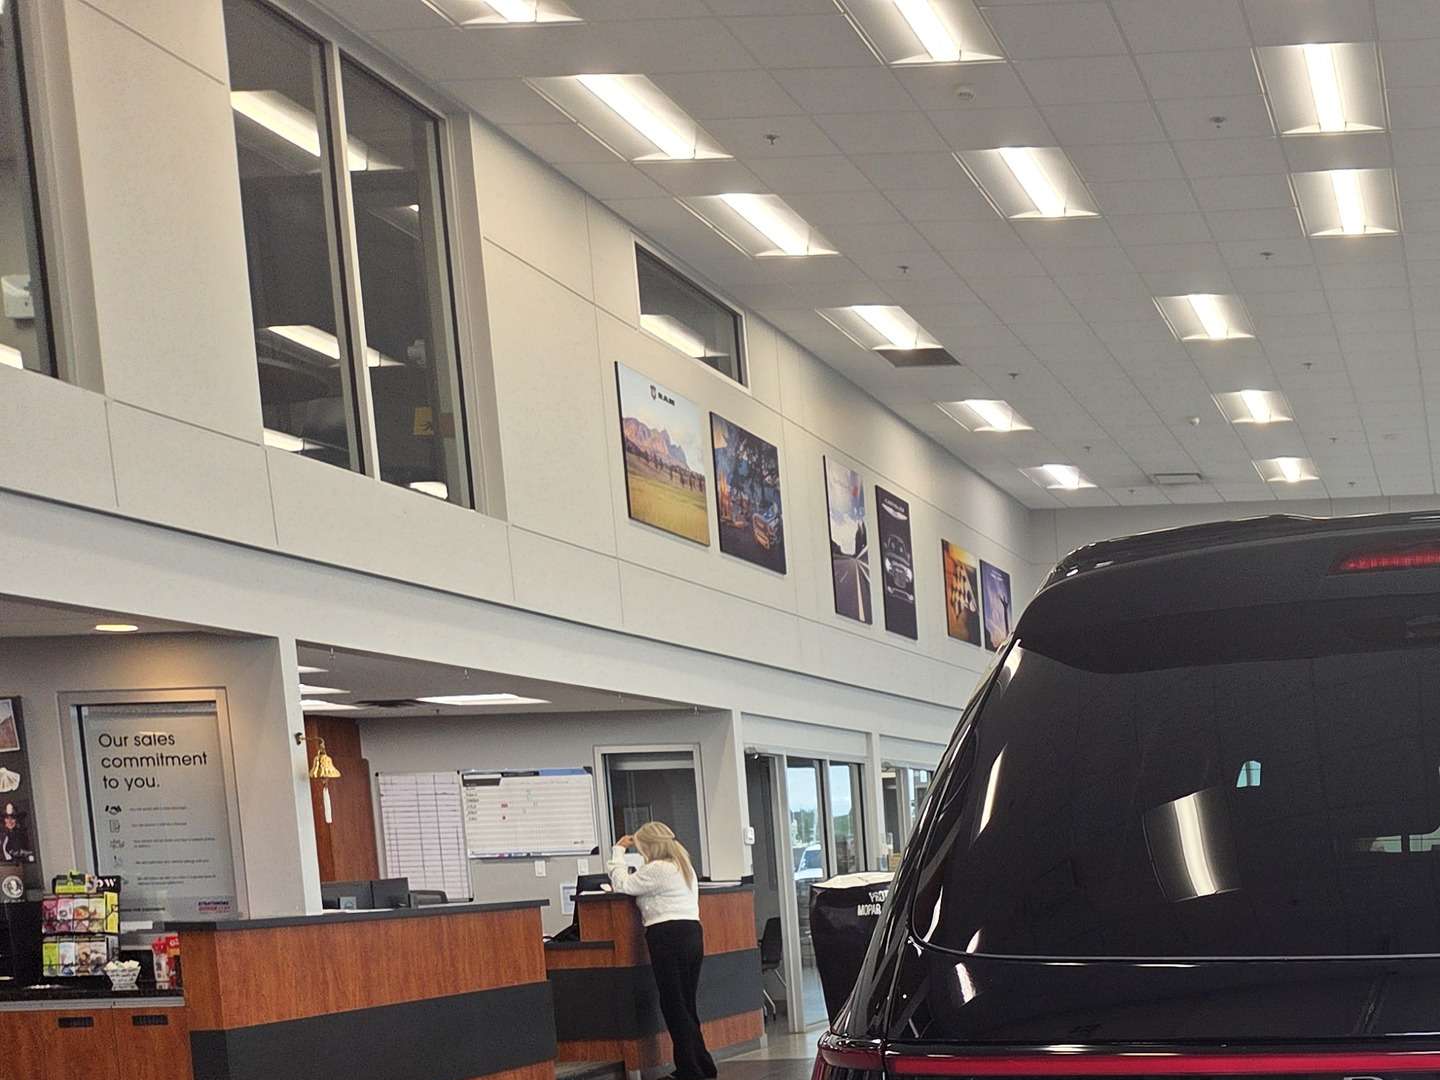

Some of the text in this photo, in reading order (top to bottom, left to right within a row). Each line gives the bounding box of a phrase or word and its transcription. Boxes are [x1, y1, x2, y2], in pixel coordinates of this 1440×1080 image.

[98, 731, 175, 748] Our sales
[101, 752, 207, 769] commitment
[102, 775, 160, 791] to you.
